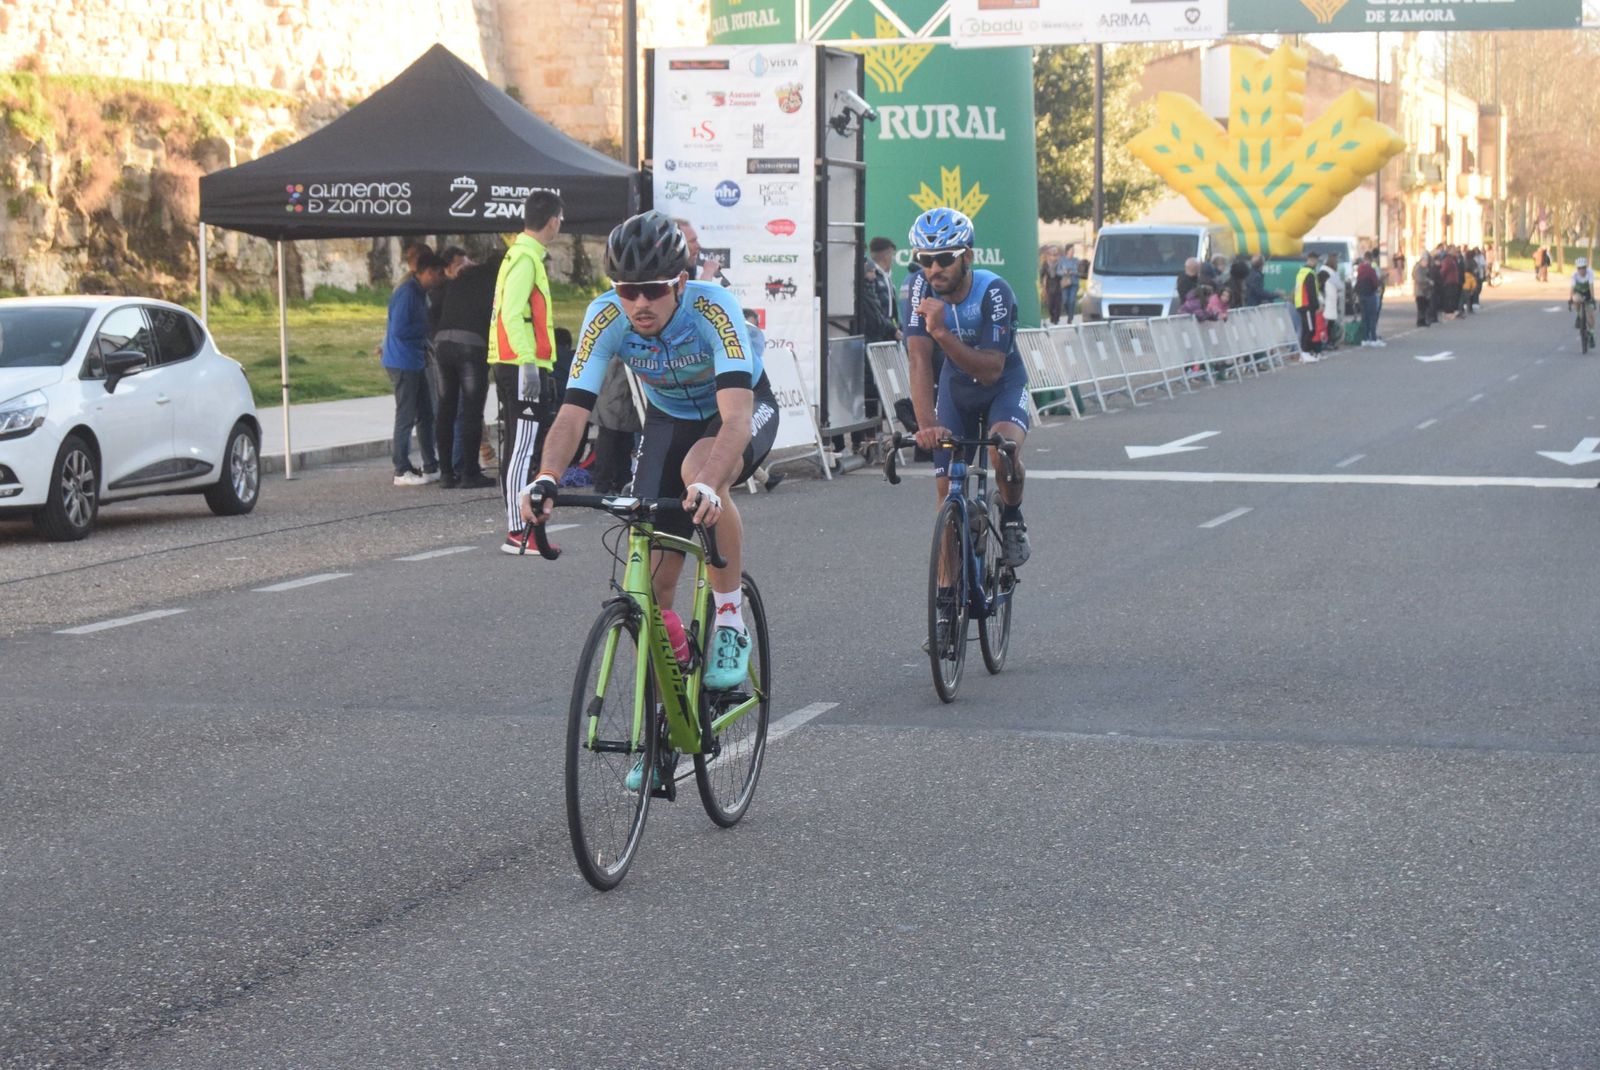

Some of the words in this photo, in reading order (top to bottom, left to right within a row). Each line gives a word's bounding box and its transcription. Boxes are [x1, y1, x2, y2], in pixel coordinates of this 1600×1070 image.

[731, 8, 780, 31] RURAL
[1100, 12, 1151, 27] ARIMA
[1365, 10, 1386, 23] DE
[1390, 9, 1456, 22] ZAMORA
[770, 59, 798, 68] VISTA
[876, 104, 1006, 140] RURAL
[308, 182, 411, 198] alimentos
[327, 199, 411, 215] zamora
[484, 202, 525, 219] ZAM
